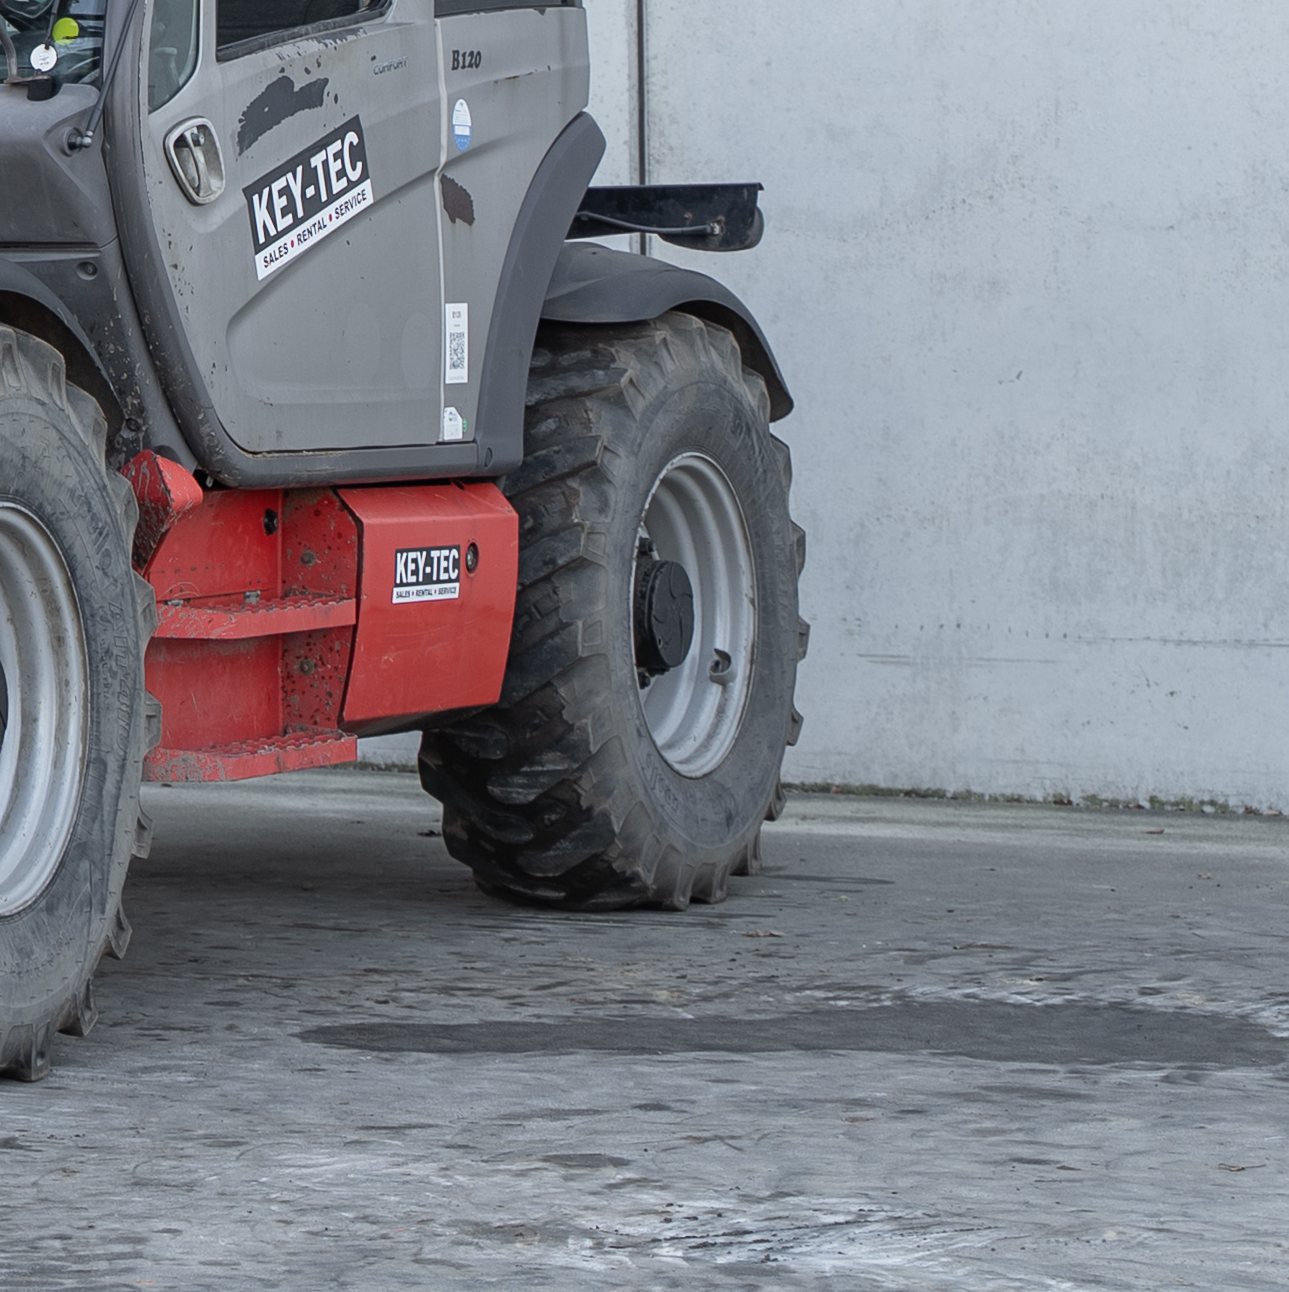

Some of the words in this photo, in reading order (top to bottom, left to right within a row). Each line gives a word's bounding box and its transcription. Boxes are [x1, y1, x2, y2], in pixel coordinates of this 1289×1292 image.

[451, 50, 482, 71] B120
[252, 131, 363, 245] KEY-TEC
[263, 242, 289, 268] SALES
[296, 217, 327, 246] RENTAL
[335, 189, 367, 219] SERVICE
[396, 549, 459, 584] KEY-TEC
